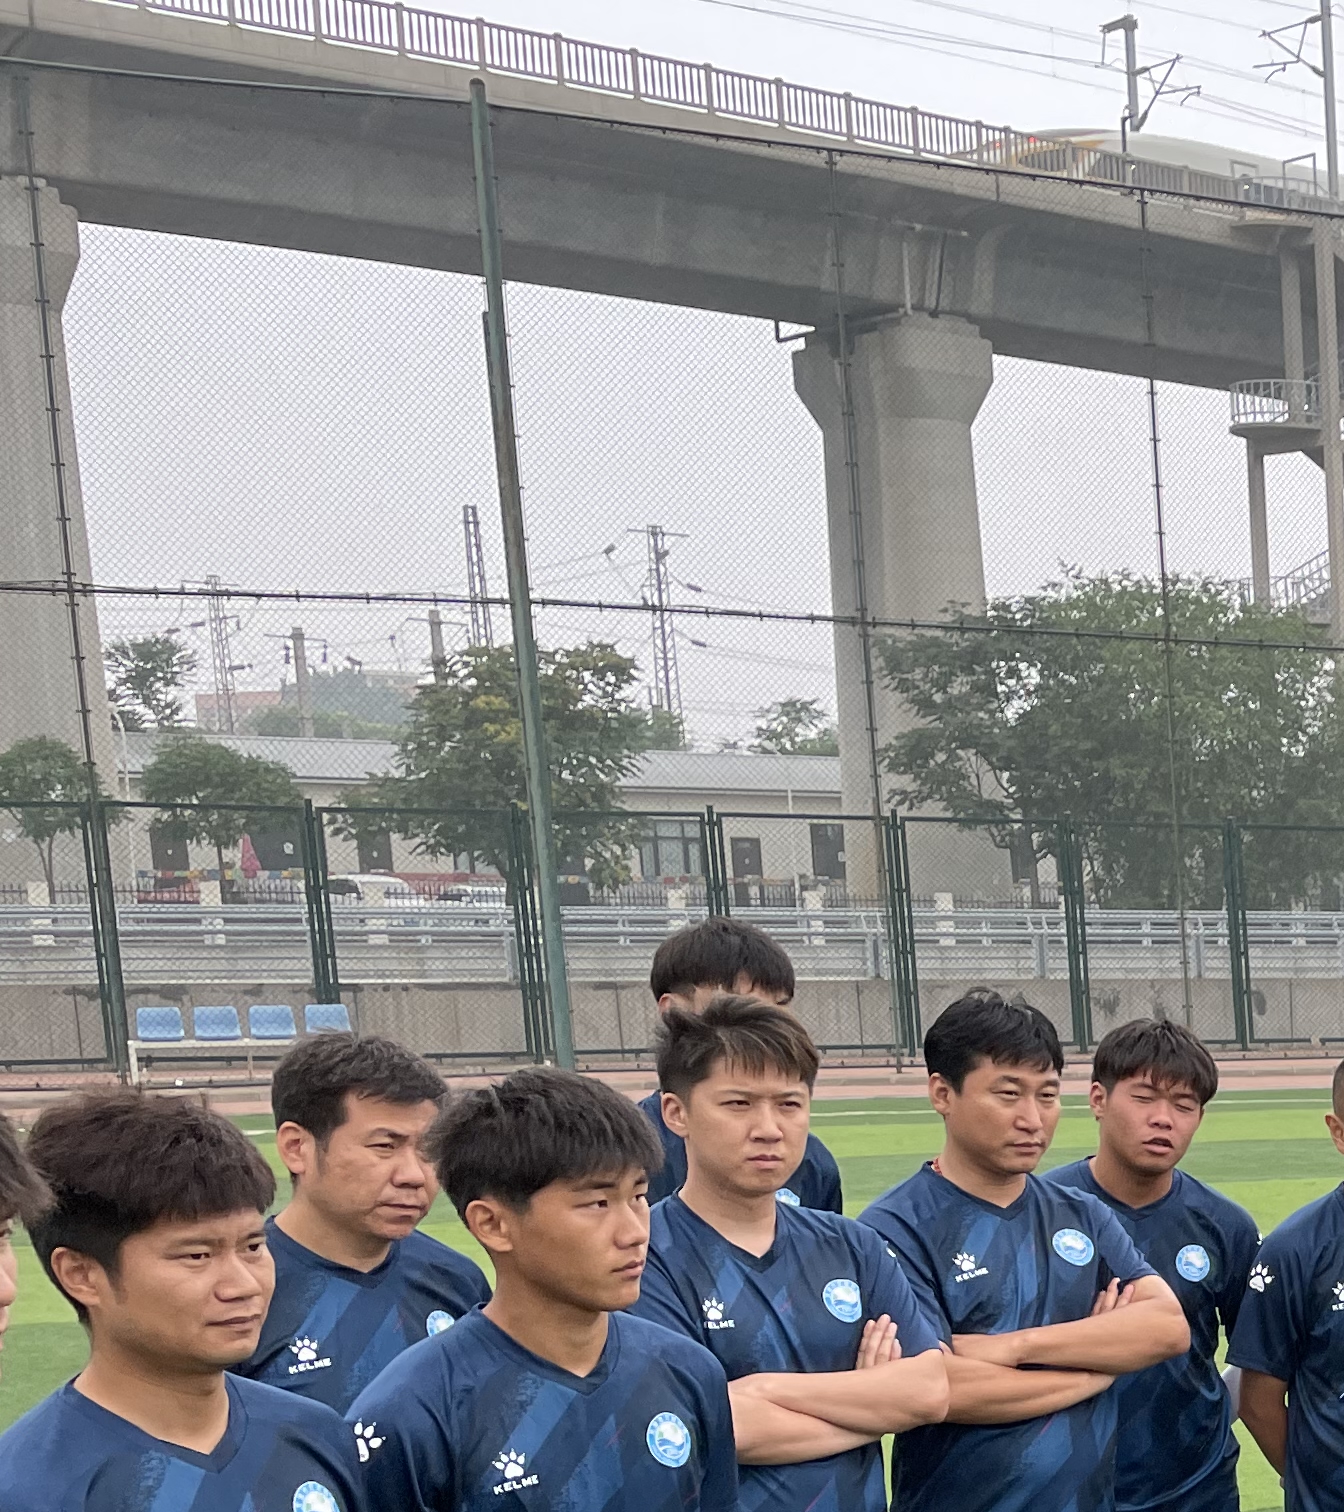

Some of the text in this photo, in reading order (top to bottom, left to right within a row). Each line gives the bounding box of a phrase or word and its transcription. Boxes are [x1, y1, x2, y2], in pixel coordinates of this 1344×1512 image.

[954, 1266, 989, 1283] KELME
[288, 1357, 332, 1375] KELME
[493, 1473, 540, 1495] KELME
